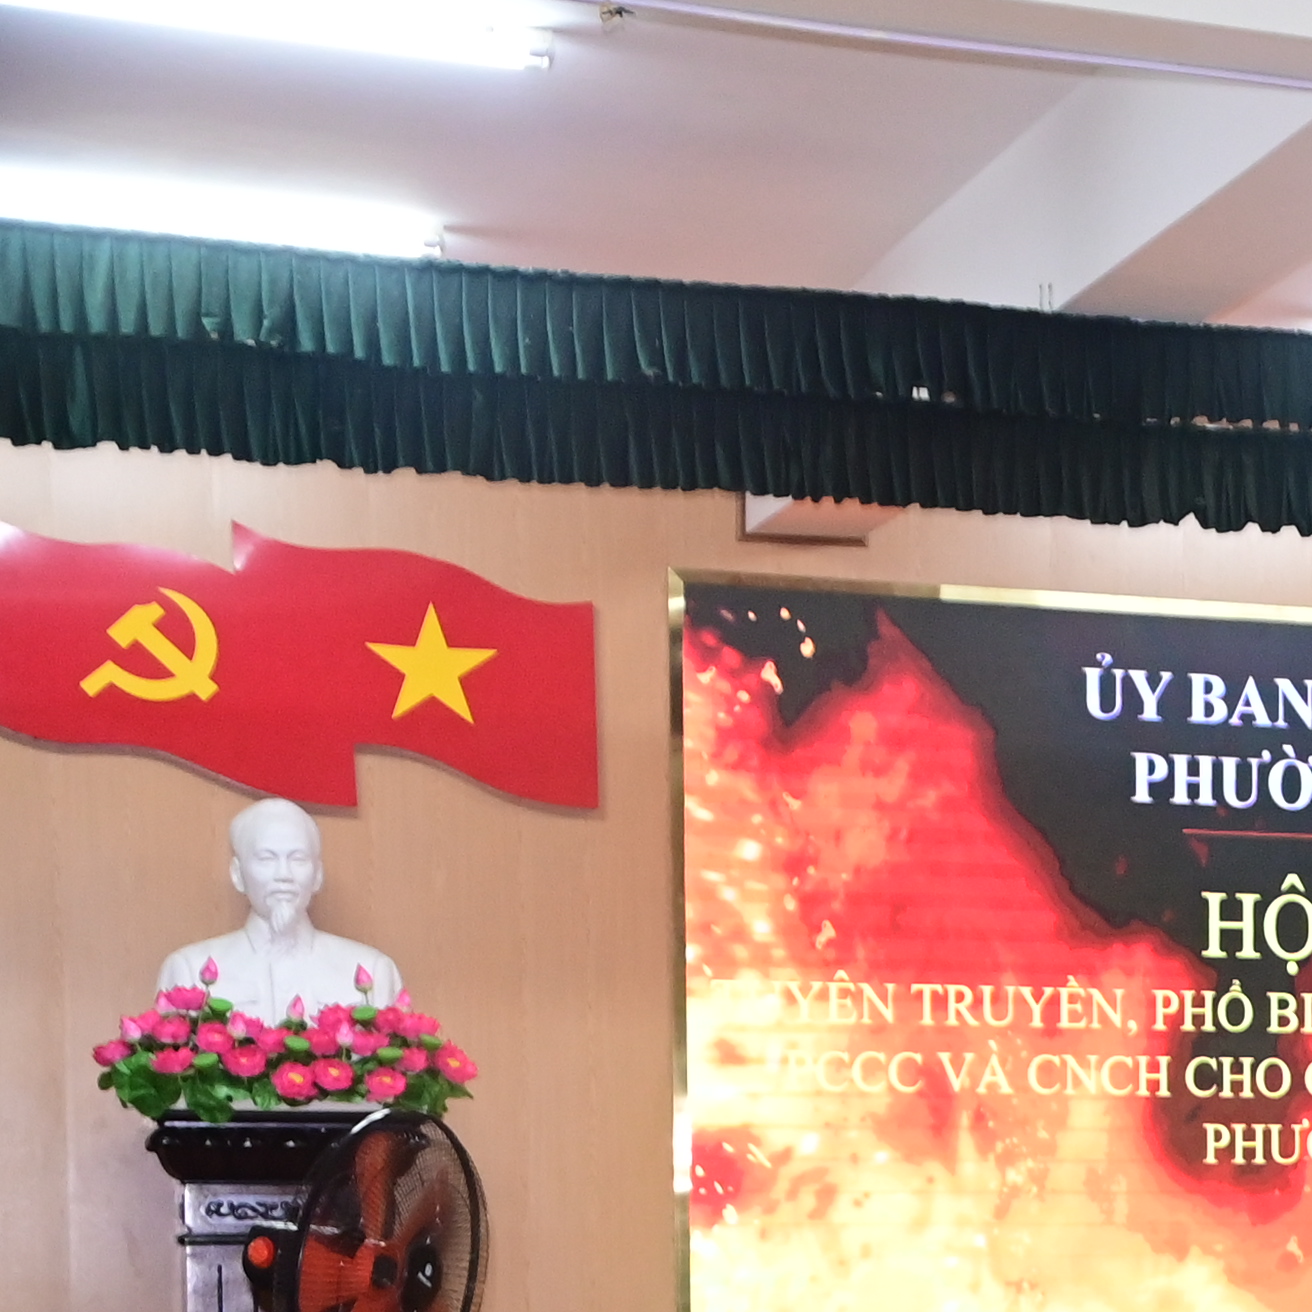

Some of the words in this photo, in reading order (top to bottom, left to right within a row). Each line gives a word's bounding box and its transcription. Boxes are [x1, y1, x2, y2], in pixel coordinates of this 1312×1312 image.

[1081, 652, 1174, 722] ỦY
[910, 974, 1138, 1036] TRUYỀN,
[1151, 975, 1254, 1033] PHỔ
[786, 1050, 923, 1093] PCCC
[937, 1039, 1014, 1095] VÀ
[1027, 1053, 1172, 1097] CNCH
[1184, 1056, 1293, 1099] CHO
